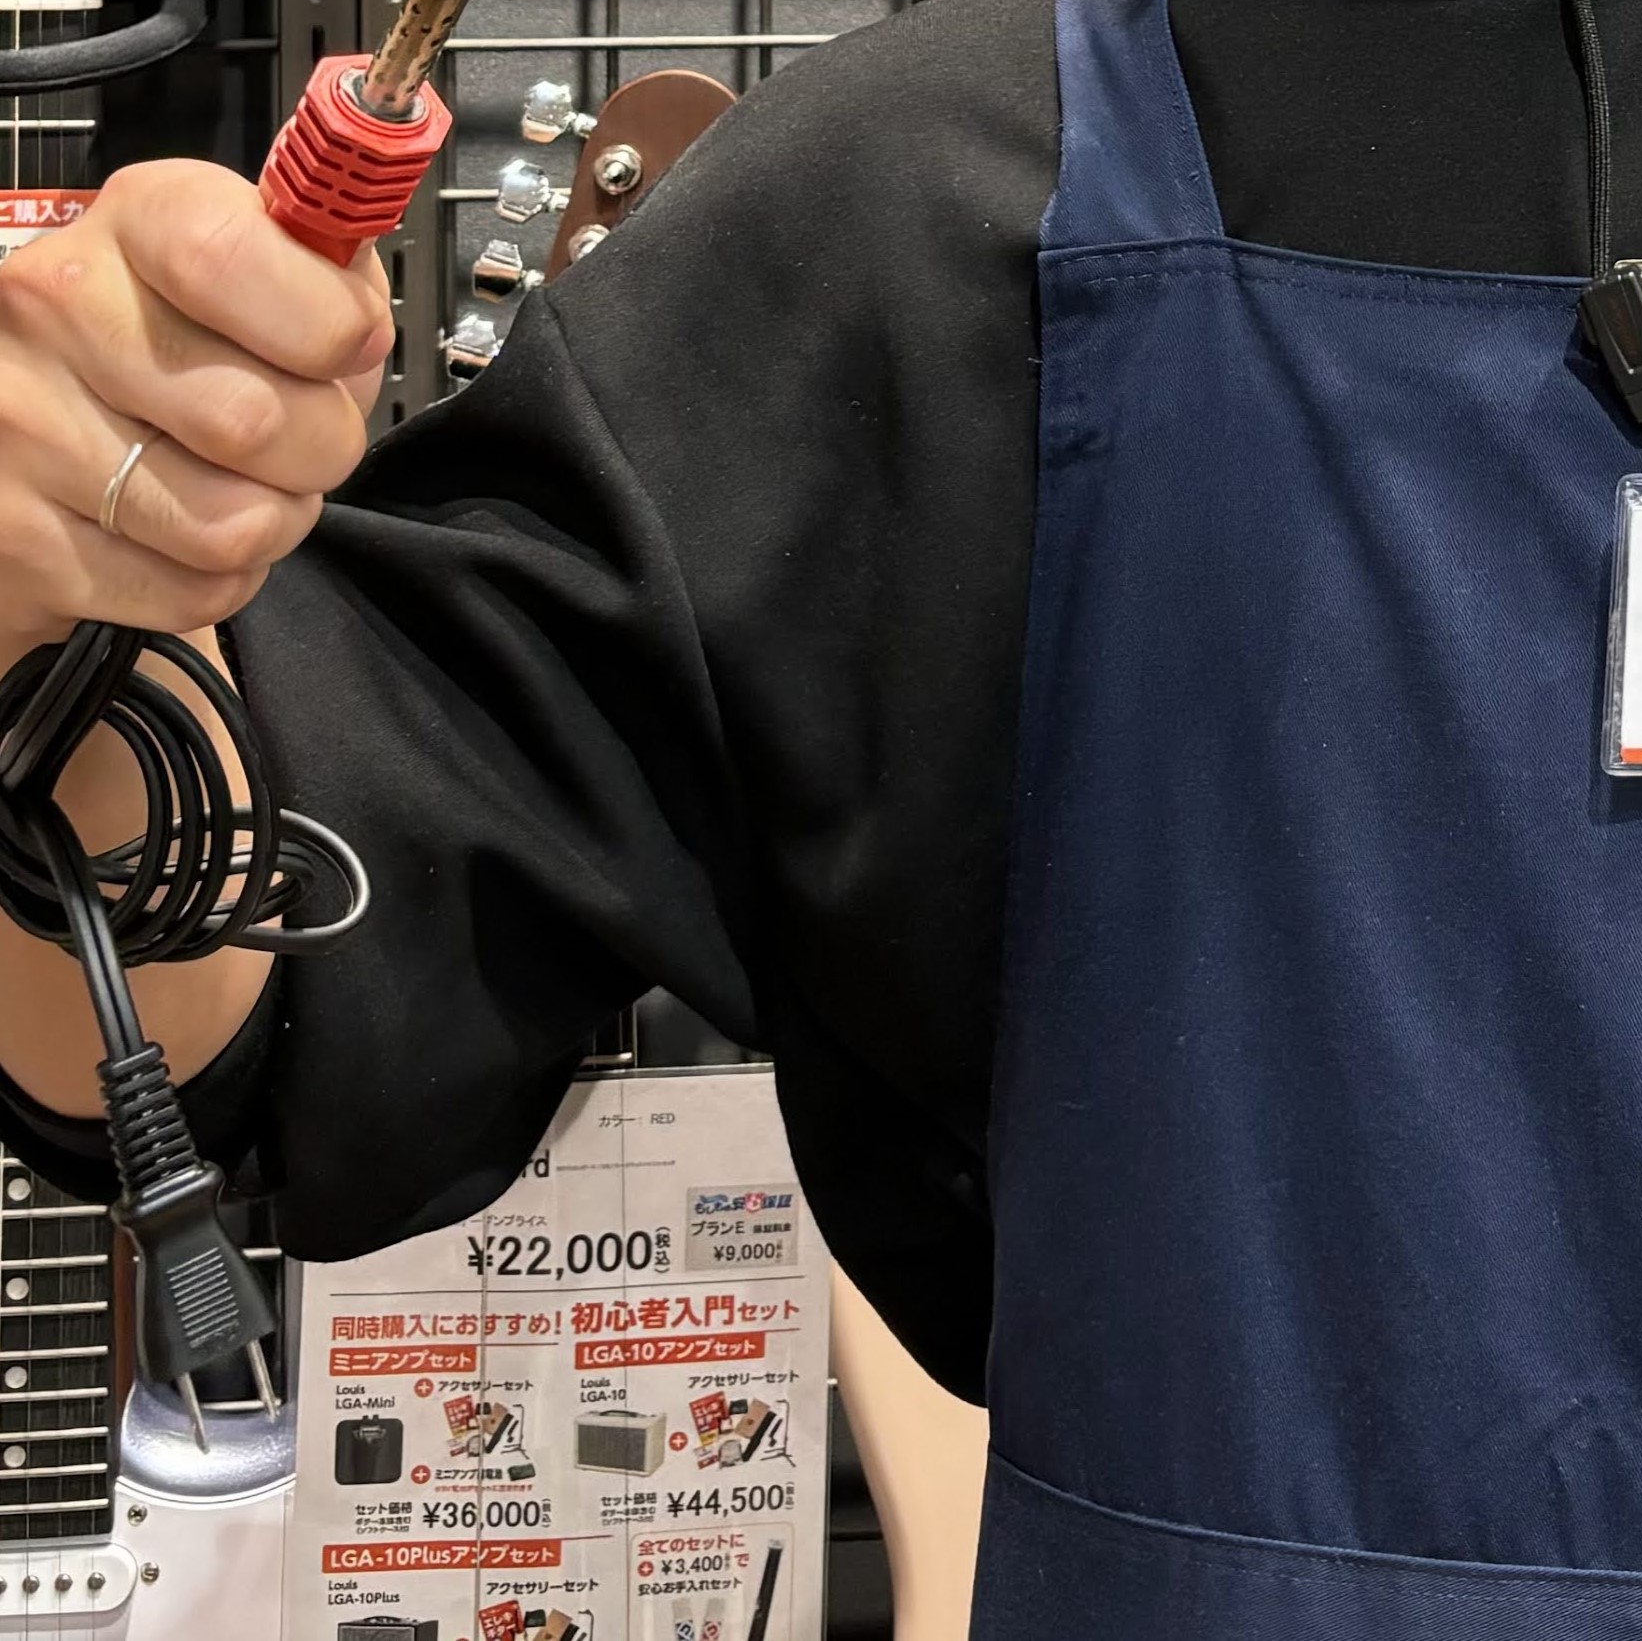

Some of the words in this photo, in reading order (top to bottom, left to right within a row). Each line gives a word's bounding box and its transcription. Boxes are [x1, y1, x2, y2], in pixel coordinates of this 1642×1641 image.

[650, 1112, 676, 1125] RED
[467, 1231, 652, 1281] ¥22,000
[714, 1242, 776, 1262] ¥9,000
[571, 1295, 800, 1334] 初心者入門セット
[333, 1348, 473, 1372] ミニアンプセット
[583, 1339, 756, 1365] LGA-10アンプセット
[437, 1379, 534, 1392] アクセサリーセット
[580, 1377, 611, 1389] Louis
[688, 1369, 800, 1389] アクセサリーセット
[336, 1384, 366, 1395] Louis
[580, 1388, 627, 1403] LGA-10
[335, 1396, 396, 1410] LGA-Mini
[667, 1484, 785, 1519] ¥44,500
[423, 1500, 541, 1530] ¥36,000
[637, 1534, 744, 1556] 全てのセットに
[330, 1543, 554, 1569] LGA-10Plusアンプセット
[661, 1555, 723, 1575] ¥3,400
[328, 1580, 358, 1591] Louis
[486, 1578, 599, 1596] アクセサリーセット
[637, 1577, 743, 1596] 安心お手入れセット
[327, 1591, 401, 1605] LGA-10Plus
